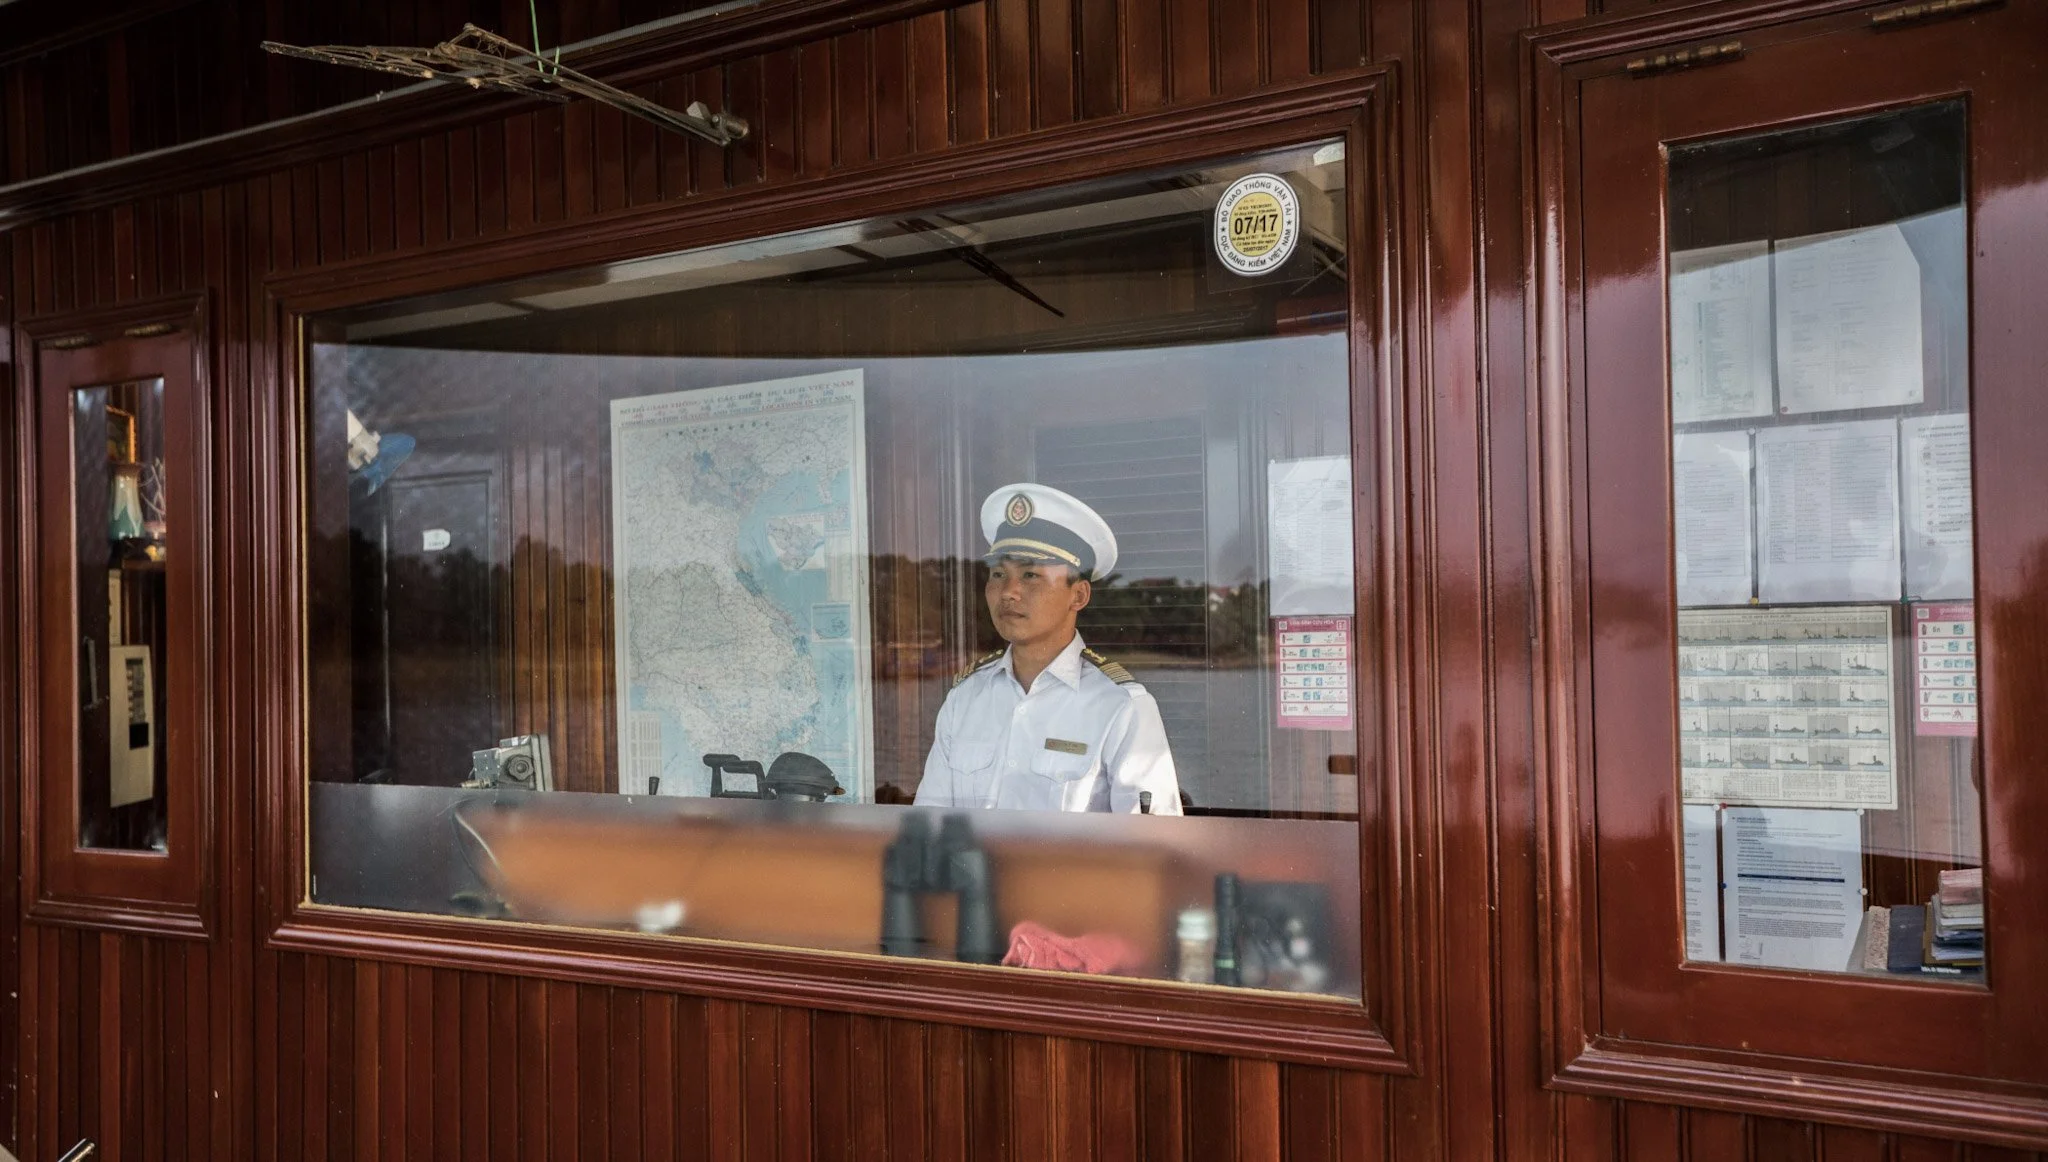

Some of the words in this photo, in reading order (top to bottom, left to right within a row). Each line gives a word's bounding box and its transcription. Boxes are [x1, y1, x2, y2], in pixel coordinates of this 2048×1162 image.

[1226, 189, 1242, 207] GIAO
[1244, 180, 1271, 190] THÔNG
[1234, 214, 1278, 235] 07/17
[1282, 230, 1291, 246] NAM
